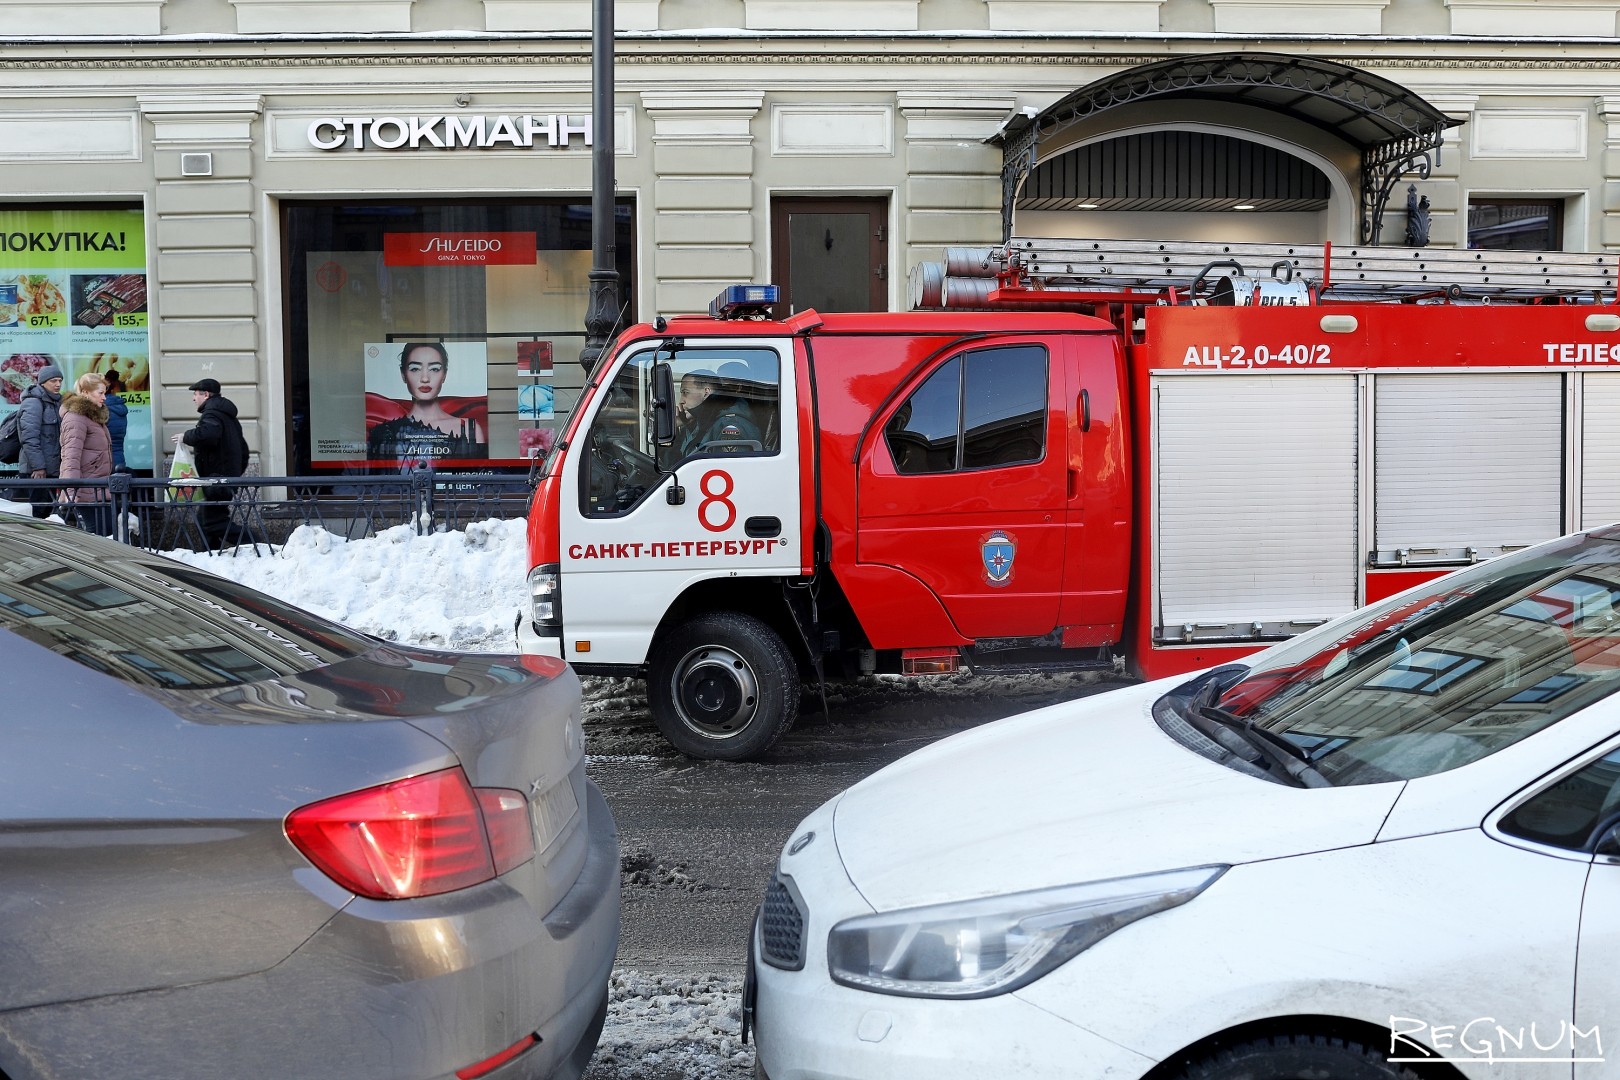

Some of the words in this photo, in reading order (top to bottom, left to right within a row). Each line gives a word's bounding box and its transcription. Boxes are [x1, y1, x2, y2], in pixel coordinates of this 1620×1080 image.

[307, 114, 593, 149] СТОКМАНН
[419, 237, 502, 253] SHISEIDO
[1183, 344, 1331, 369] АЦ-2,0-40/2
[404, 445, 450, 455] SHISEIDO
[697, 469, 737, 533] 8
[568, 539, 779, 560] САНКТ-ПЕТЕРБУРГ
